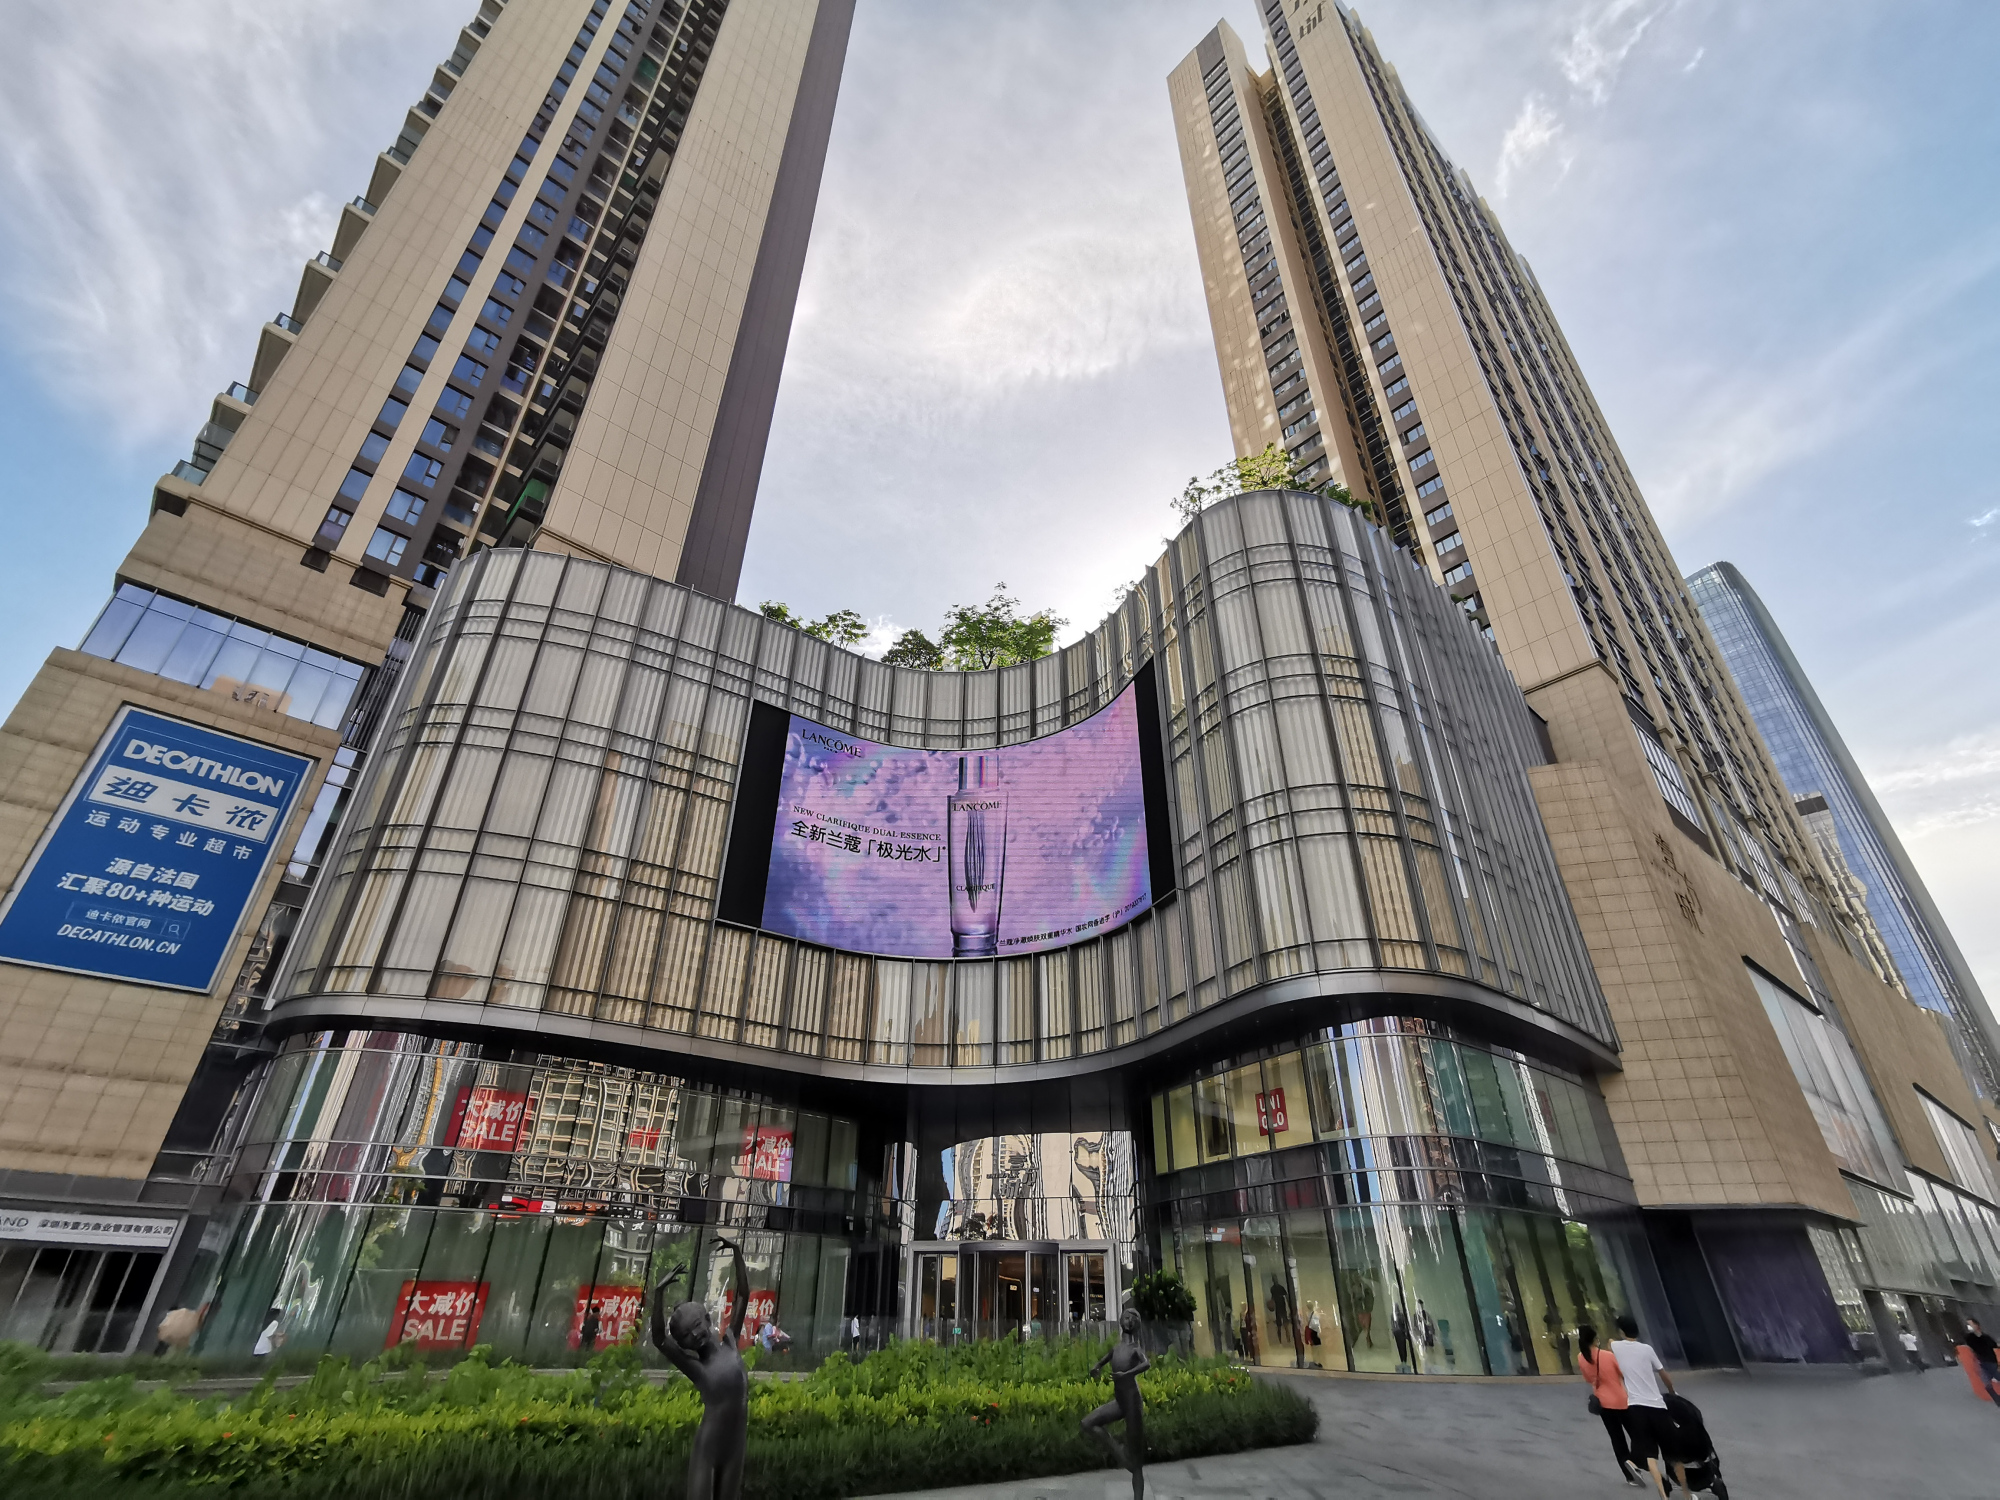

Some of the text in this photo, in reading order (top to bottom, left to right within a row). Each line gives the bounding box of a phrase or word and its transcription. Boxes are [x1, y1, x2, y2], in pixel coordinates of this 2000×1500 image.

[802, 728, 861, 757] LANCÔME
[123, 739, 284, 798] DECATHLON
[102, 775, 267, 831] 迪卡侬
[84, 809, 252, 860] 运动专业超市
[793, 805, 941, 841] NEW CLARIFIQUE DUAL ESSENCE
[105, 857, 199, 890] 源自法国
[56, 872, 215, 917] 汇聚80+种运动
[85, 908, 152, 930] 迪卡侬官网
[56, 923, 181, 955] DECATHLON.CN
[459, 1096, 523, 1123] 大减价
[460, 1120, 515, 1141] SALE
[746, 1132, 792, 1157] 大减价
[0, 1216, 29, 1228] ND
[401, 1290, 479, 1316] 大减价
[401, 1318, 466, 1342] SALE
